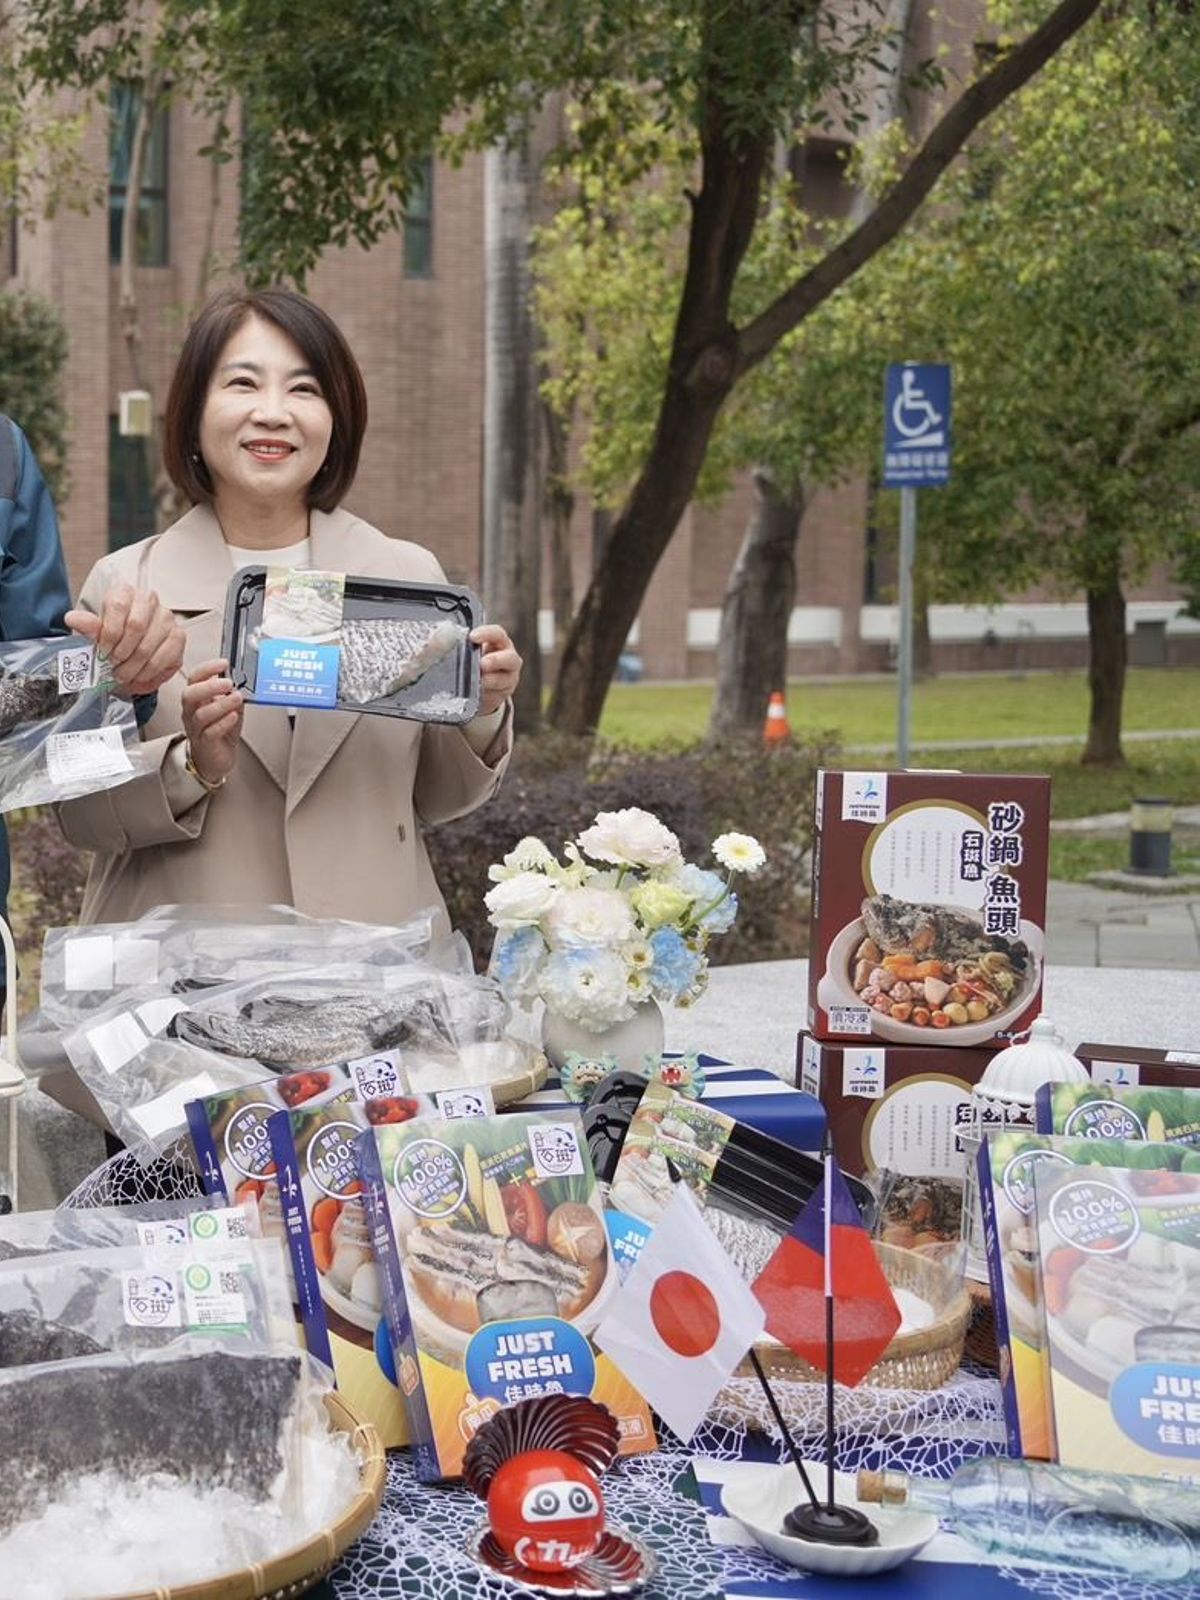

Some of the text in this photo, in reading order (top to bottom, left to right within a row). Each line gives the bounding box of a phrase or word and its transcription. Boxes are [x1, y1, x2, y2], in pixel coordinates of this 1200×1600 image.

[282, 649, 318, 660] JUST
[963, 834, 980, 878] 石斑魚
[987, 805, 1021, 934] 砂鍋魚頭
[235, 1119, 269, 1156] 100
[404, 1153, 454, 1190] 100%
[1061, 1196, 1125, 1223] 100%
[496, 1330, 555, 1356] JUST
[488, 1354, 573, 1382] FRESH
[1153, 1375, 1200, 1399] JU
[1140, 1398, 1200, 1423] FRE
